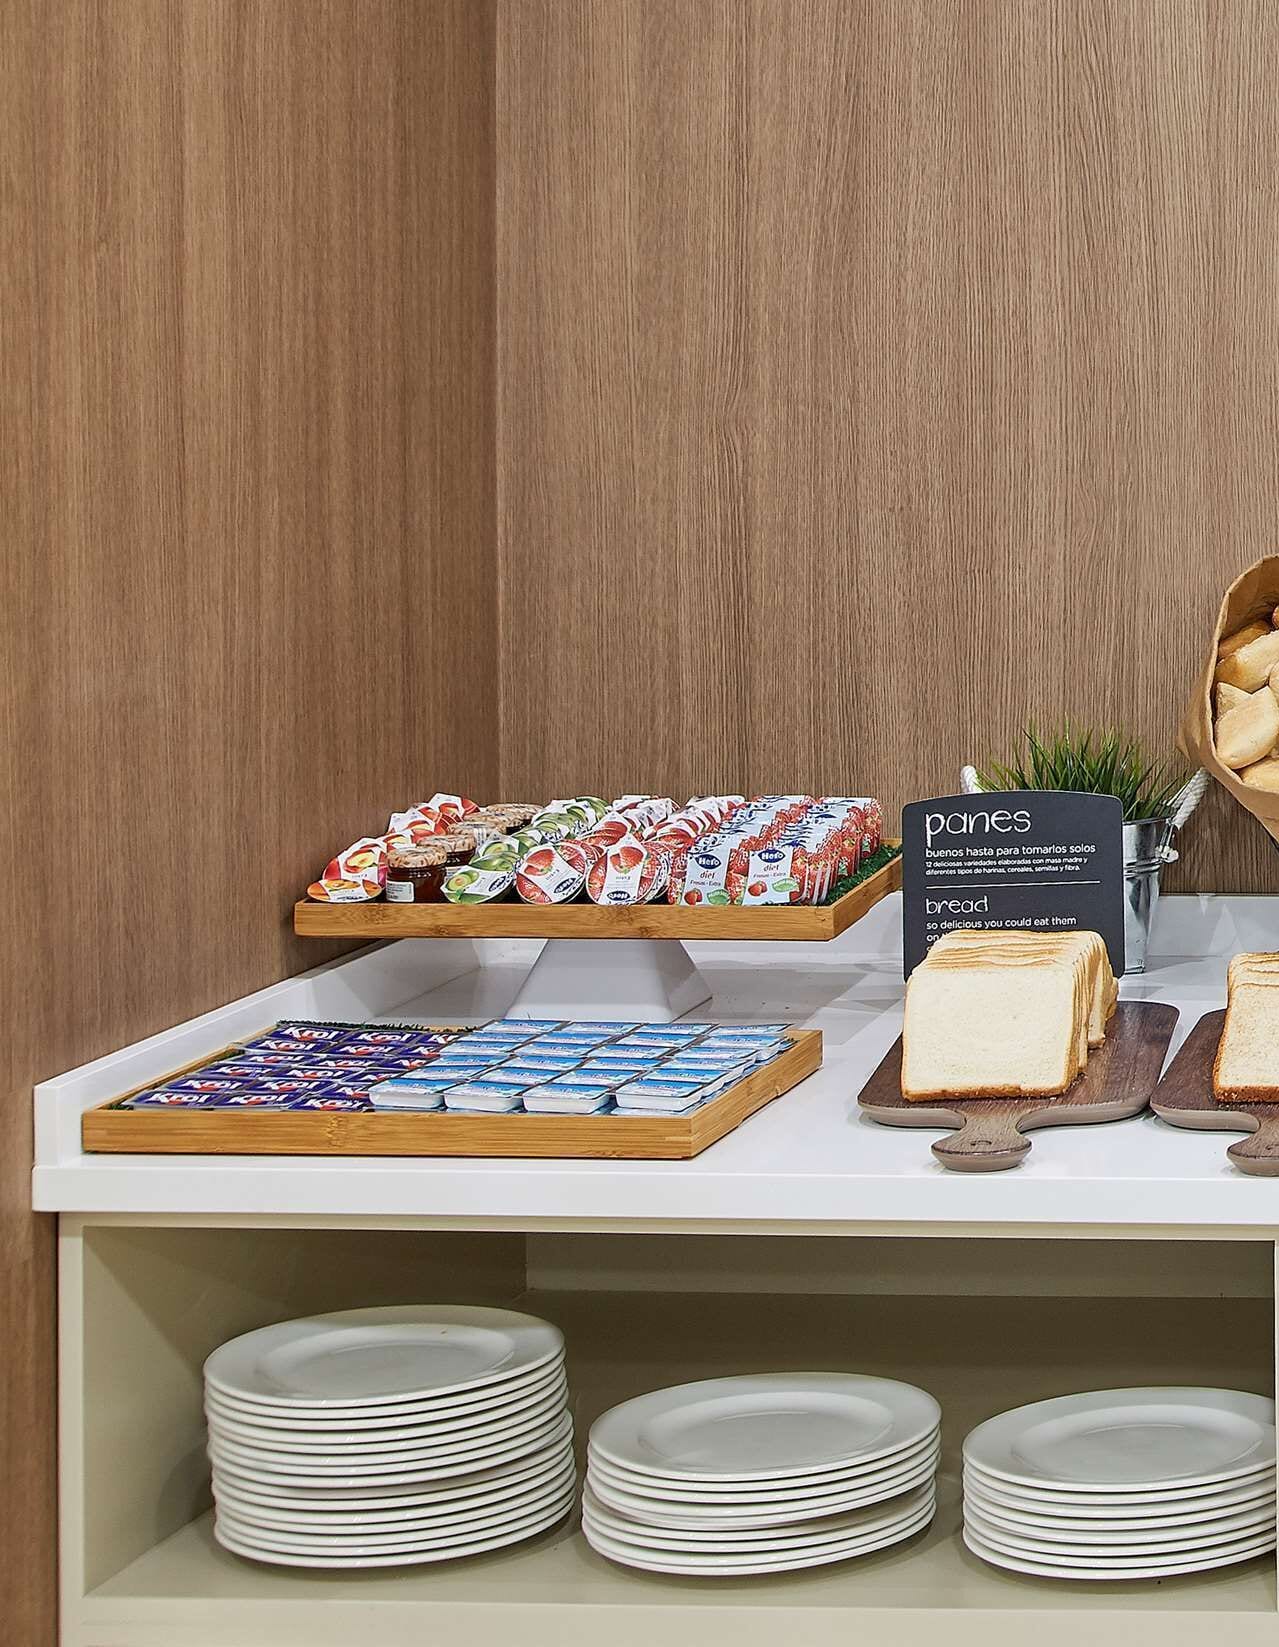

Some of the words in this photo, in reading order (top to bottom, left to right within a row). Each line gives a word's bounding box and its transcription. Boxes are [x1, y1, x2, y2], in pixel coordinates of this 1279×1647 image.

[926, 810, 1032, 848] panes
[762, 852, 783, 860] Hero
[926, 848, 964, 858] buenos
[966, 846, 994, 857] hasta
[996, 847, 1019, 857] para
[1022, 844, 1067, 855] tomarlos
[1069, 844, 1096, 853] solos
[698, 857, 720, 866] Hero
[926, 895, 988, 914] bread
[940, 918, 982, 929] delicious
[984, 920, 1003, 929] you
[1005, 917, 1032, 927] could
[1034, 918, 1049, 927] eat
[1051, 917, 1077, 926] them
[280, 1027, 341, 1040] Krol
[354, 1033, 412, 1042] Krol
[256, 1040, 316, 1050] Krol
[181, 1080, 243, 1089] Krol
[258, 1081, 320, 1090] Krol
[147, 1093, 210, 1103] Krol
[227, 1094, 289, 1102] Krol
